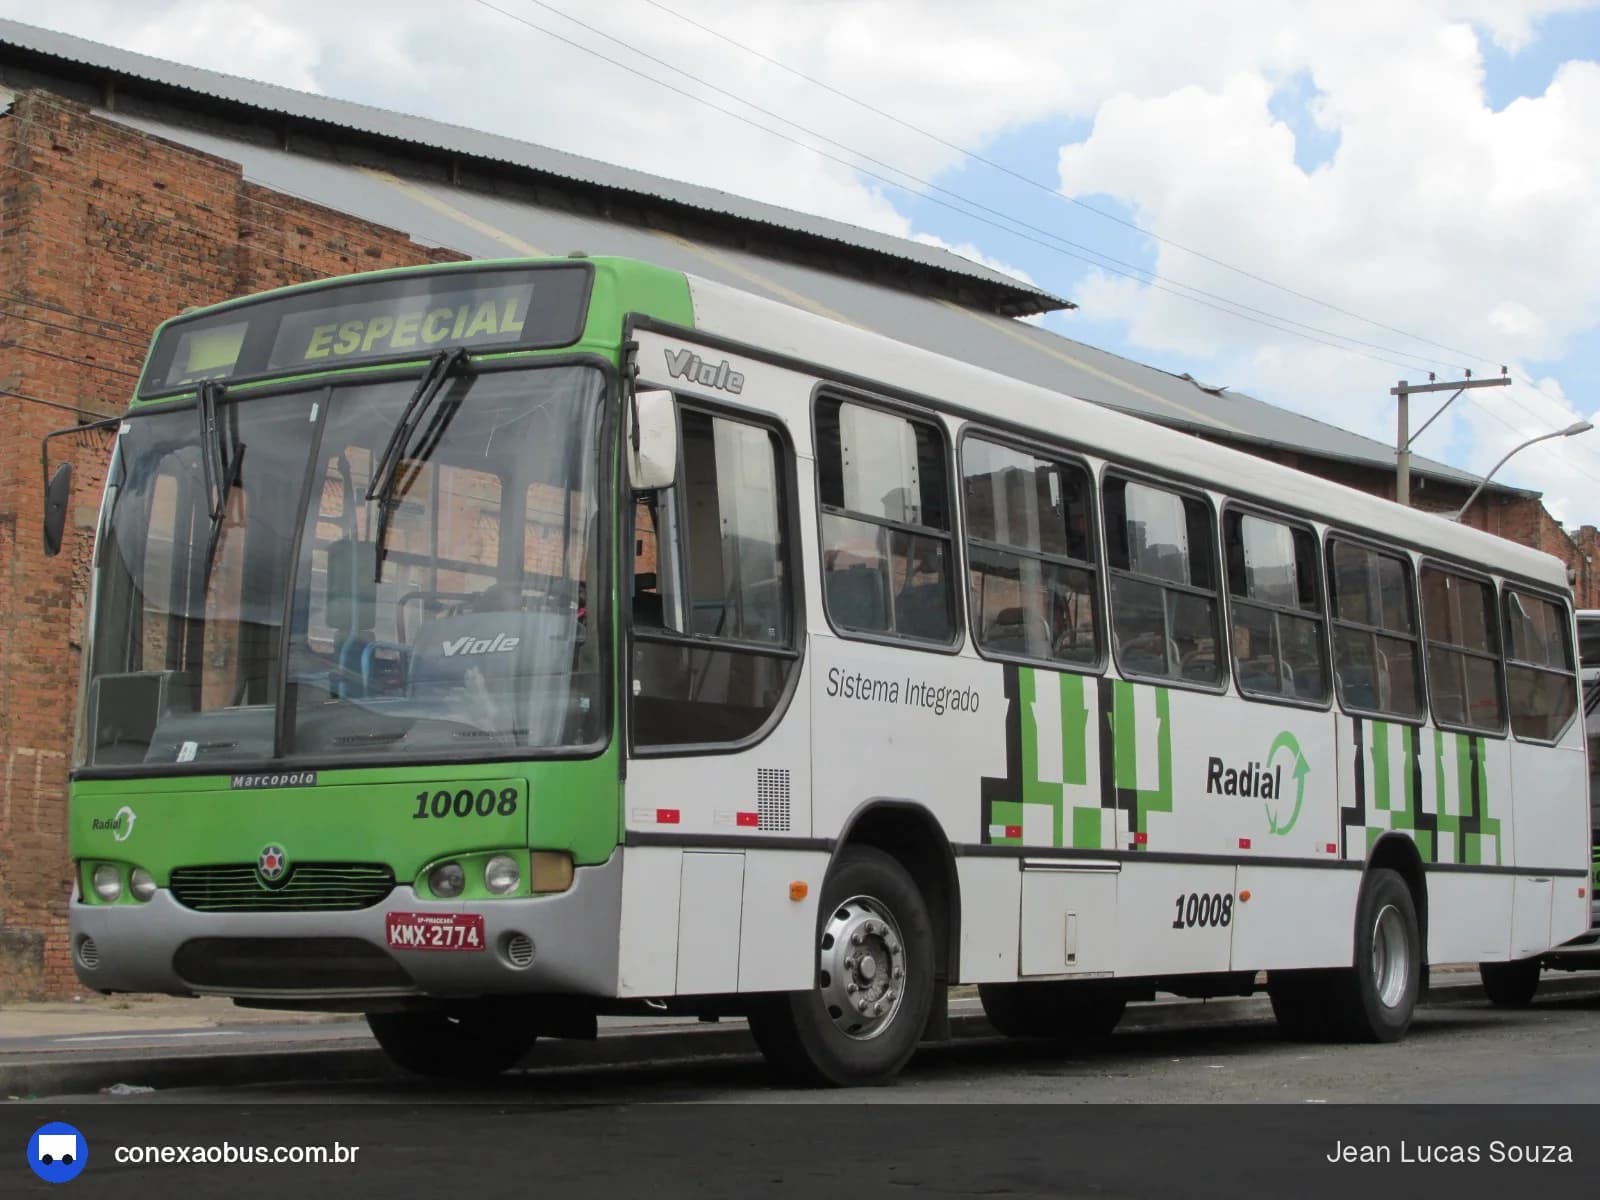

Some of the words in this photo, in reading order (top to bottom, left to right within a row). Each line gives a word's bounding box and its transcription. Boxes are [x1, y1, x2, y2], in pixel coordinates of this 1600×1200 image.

[304, 299, 525, 360] ESPECIAL
[664, 348, 744, 394] Viale
[442, 633, 519, 657] Viale
[826, 667, 899, 704] Sistema
[904, 677, 979, 716] Integrado
[232, 773, 314, 788] Marcopolo
[1206, 756, 1281, 800] Radial
[412, 787, 518, 819] 10008
[92, 818, 122, 831] Radial
[1172, 893, 1234, 929] 10008
